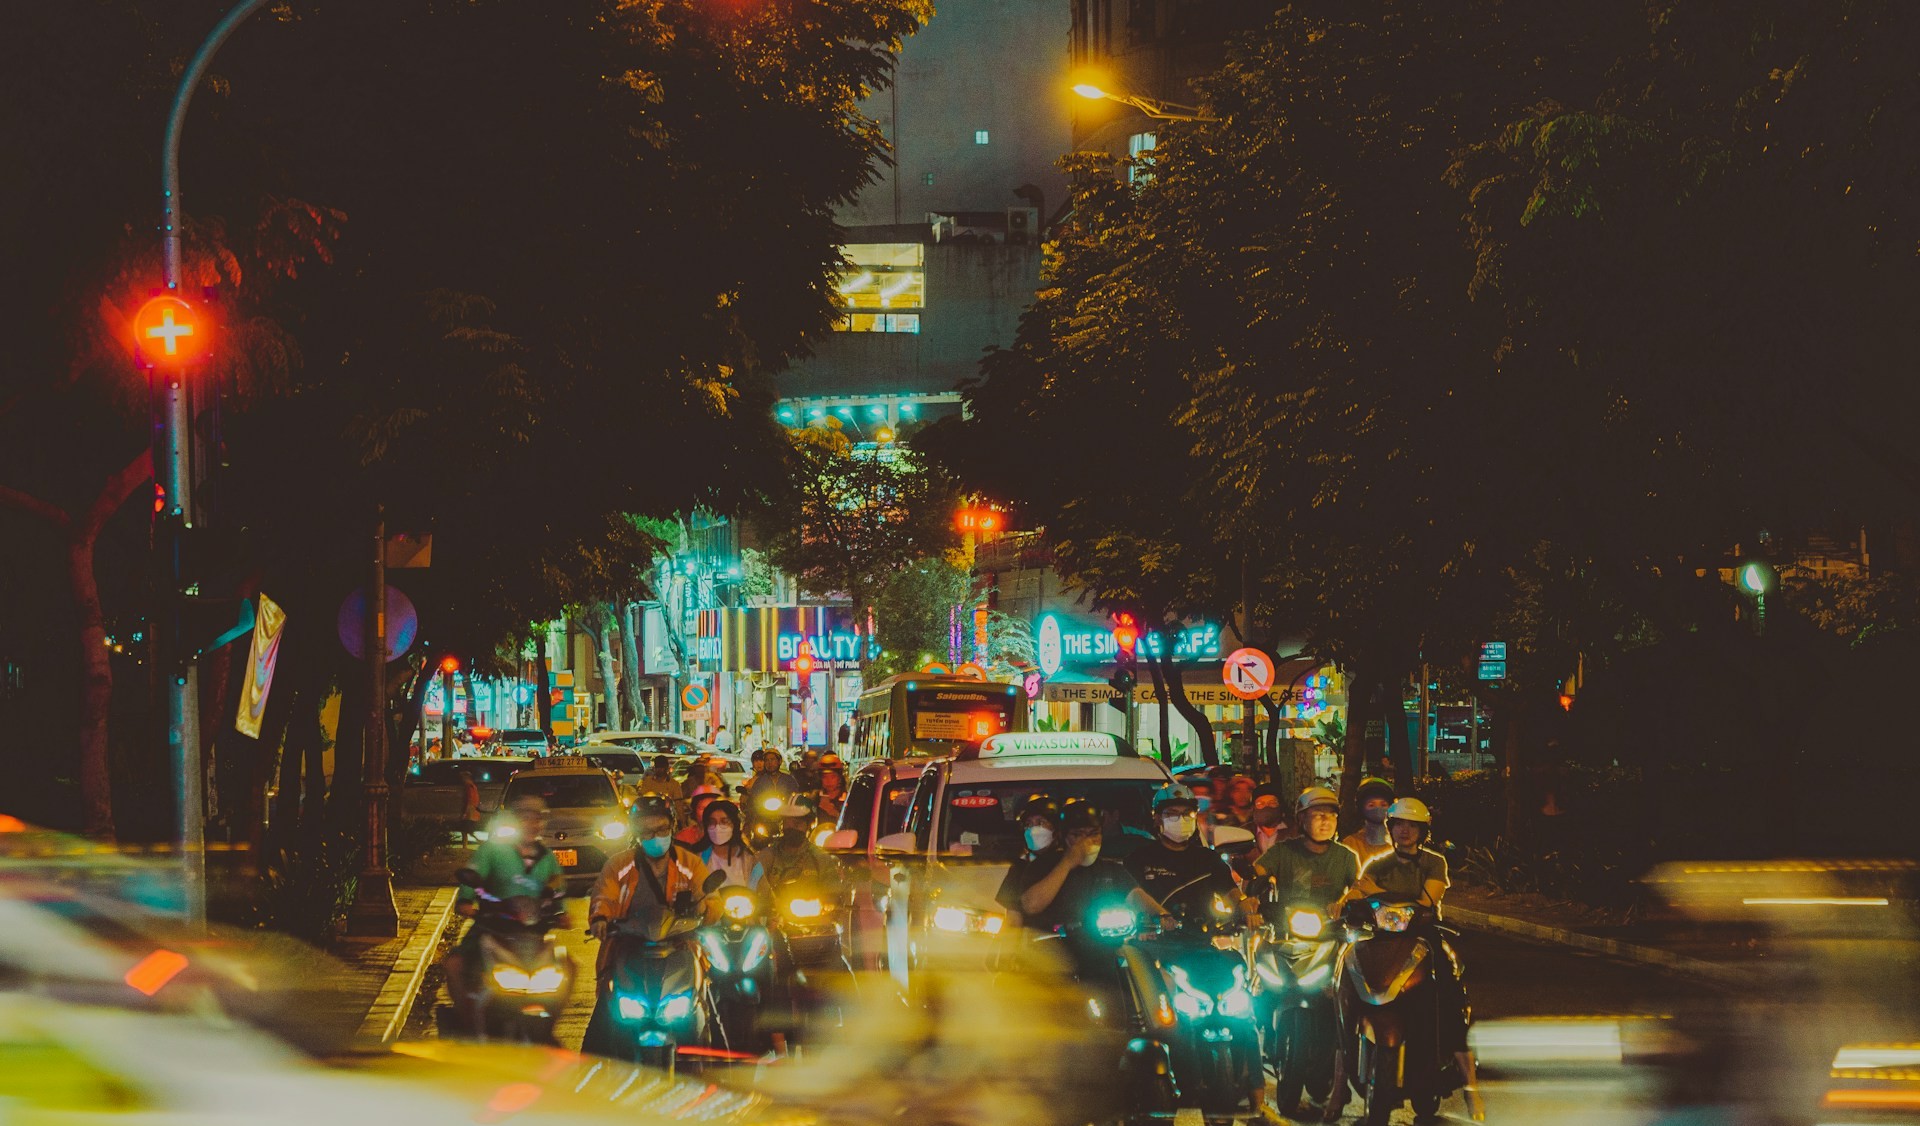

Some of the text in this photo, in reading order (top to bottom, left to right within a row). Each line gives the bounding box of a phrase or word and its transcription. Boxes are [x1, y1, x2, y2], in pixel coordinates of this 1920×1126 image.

[1063, 634, 1091, 654] THE
[1063, 689, 1086, 699] THE
[1091, 689, 1136, 699] SIMP
[1190, 691, 1214, 700] THE
[1013, 738, 1109, 750] VINASUN TAXI
[954, 798, 995, 806] 18492
